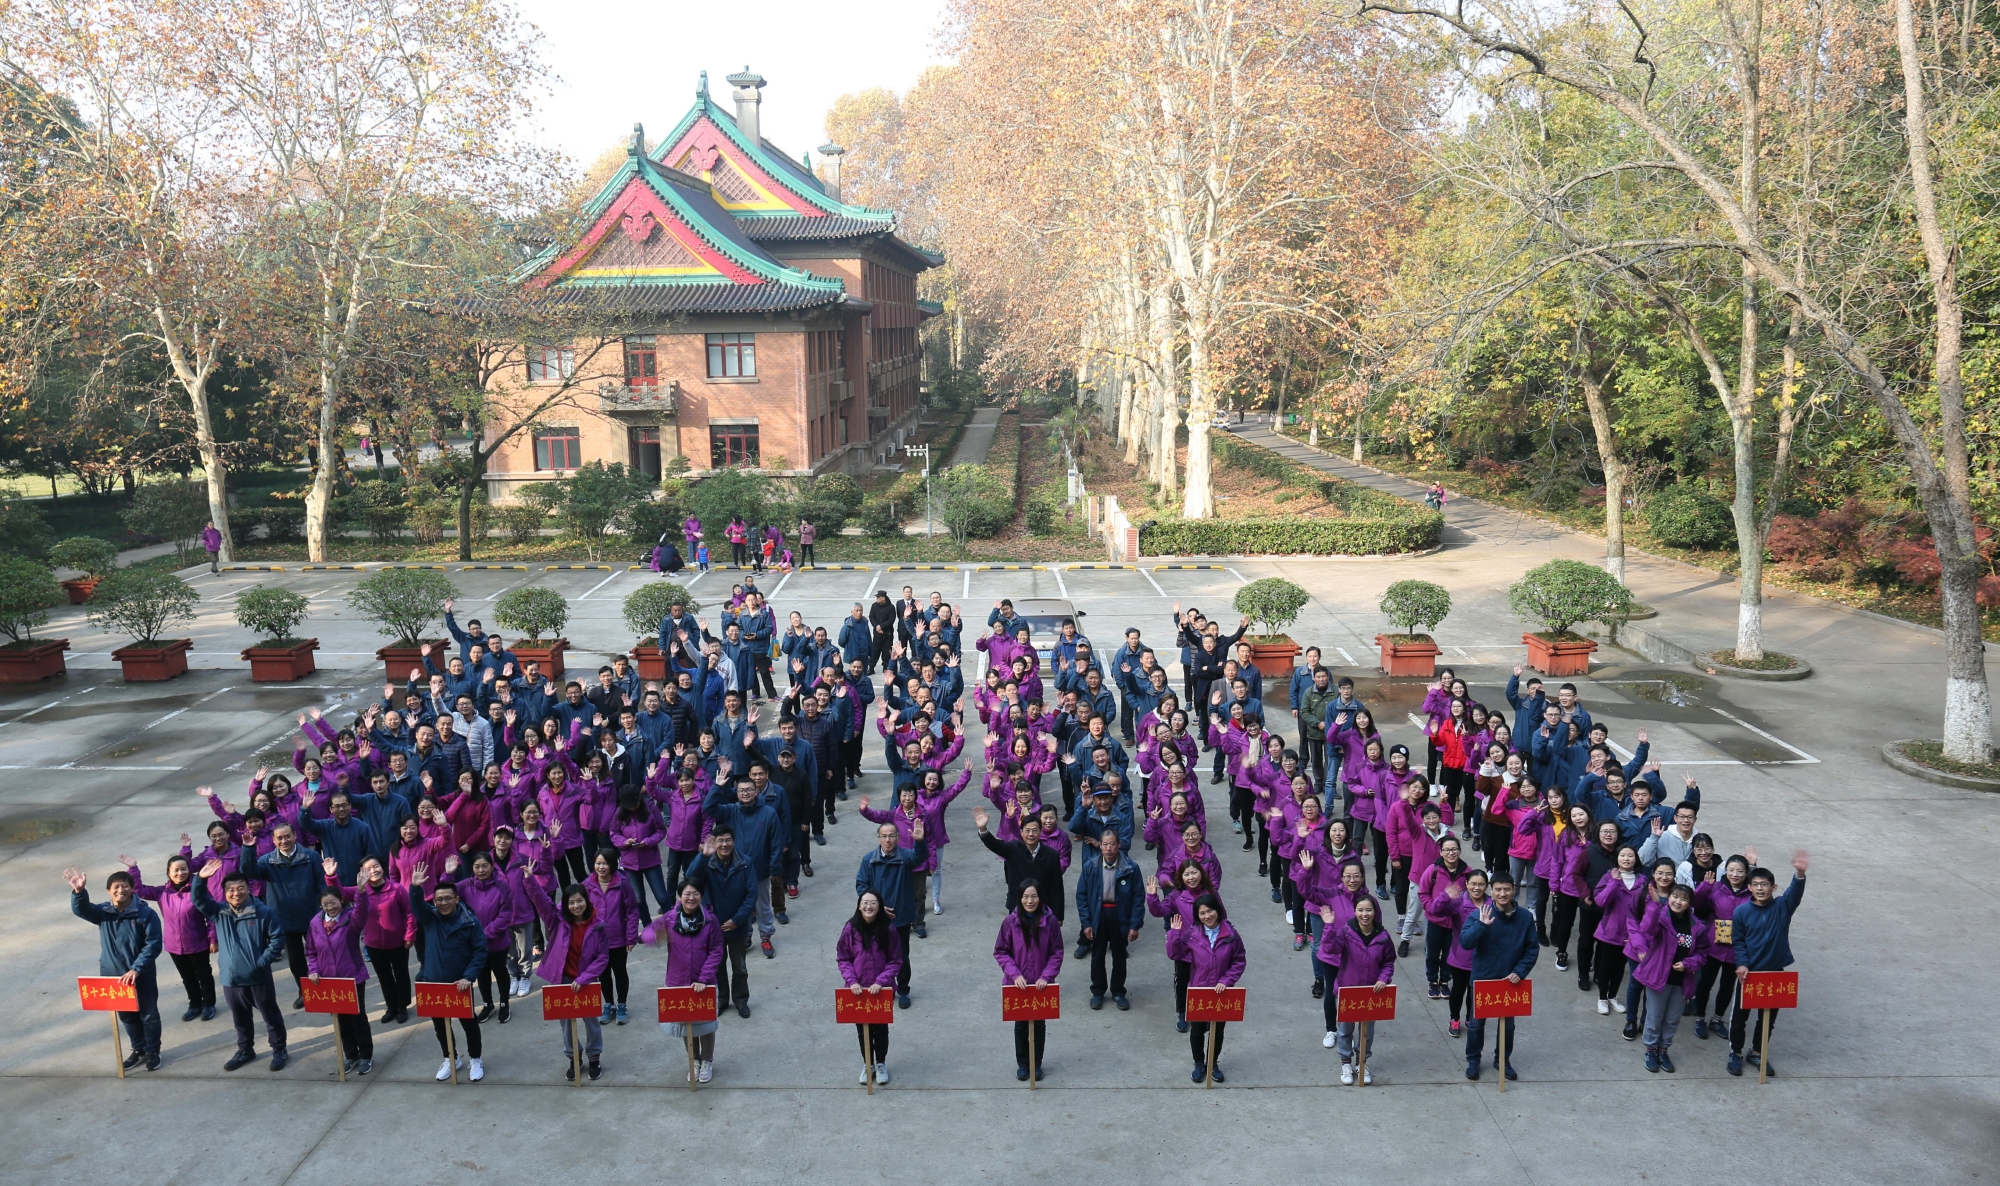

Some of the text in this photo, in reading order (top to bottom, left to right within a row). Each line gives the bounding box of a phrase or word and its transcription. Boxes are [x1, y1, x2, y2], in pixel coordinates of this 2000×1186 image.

[81, 984, 135, 999] 第十工会小组
[304, 989, 355, 1003] 第八工会小组
[1744, 982, 1796, 998] 研究生小组
[416, 993, 470, 1008] 第六工会小组
[544, 996, 600, 1012] 第四工会小组
[659, 998, 715, 1013] 第二工会小组
[836, 998, 892, 1014] 第一工会小组
[1003, 997, 1058, 1012] 第三工会小组
[1188, 998, 1241, 1013] 第五工会小组
[1340, 997, 1393, 1013] 第七工会小组
[1475, 991, 1530, 1008] 第九工会小组
